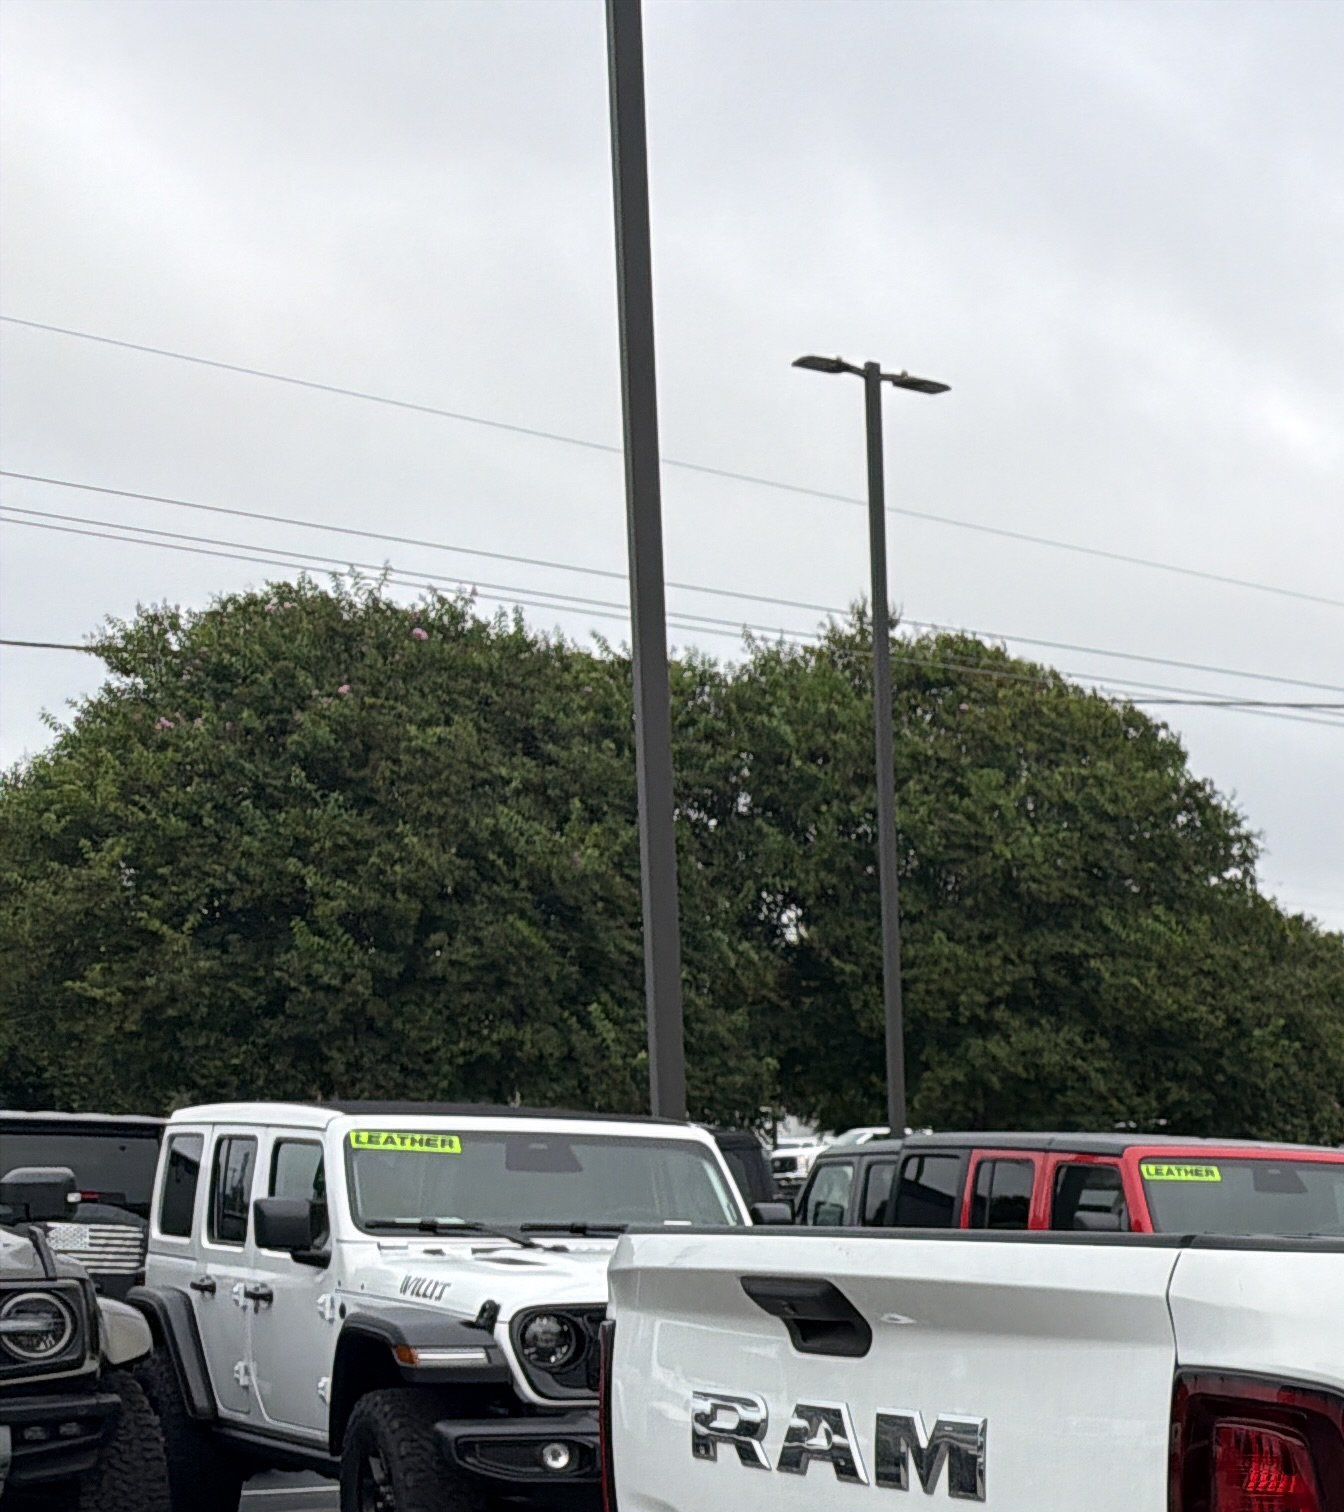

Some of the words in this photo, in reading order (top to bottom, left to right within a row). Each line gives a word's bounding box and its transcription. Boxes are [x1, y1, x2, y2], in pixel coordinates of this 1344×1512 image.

[354, 1132, 455, 1150] LEATHER
[1145, 1165, 1216, 1179] LEATHER
[691, 1390, 988, 1503] RAM
